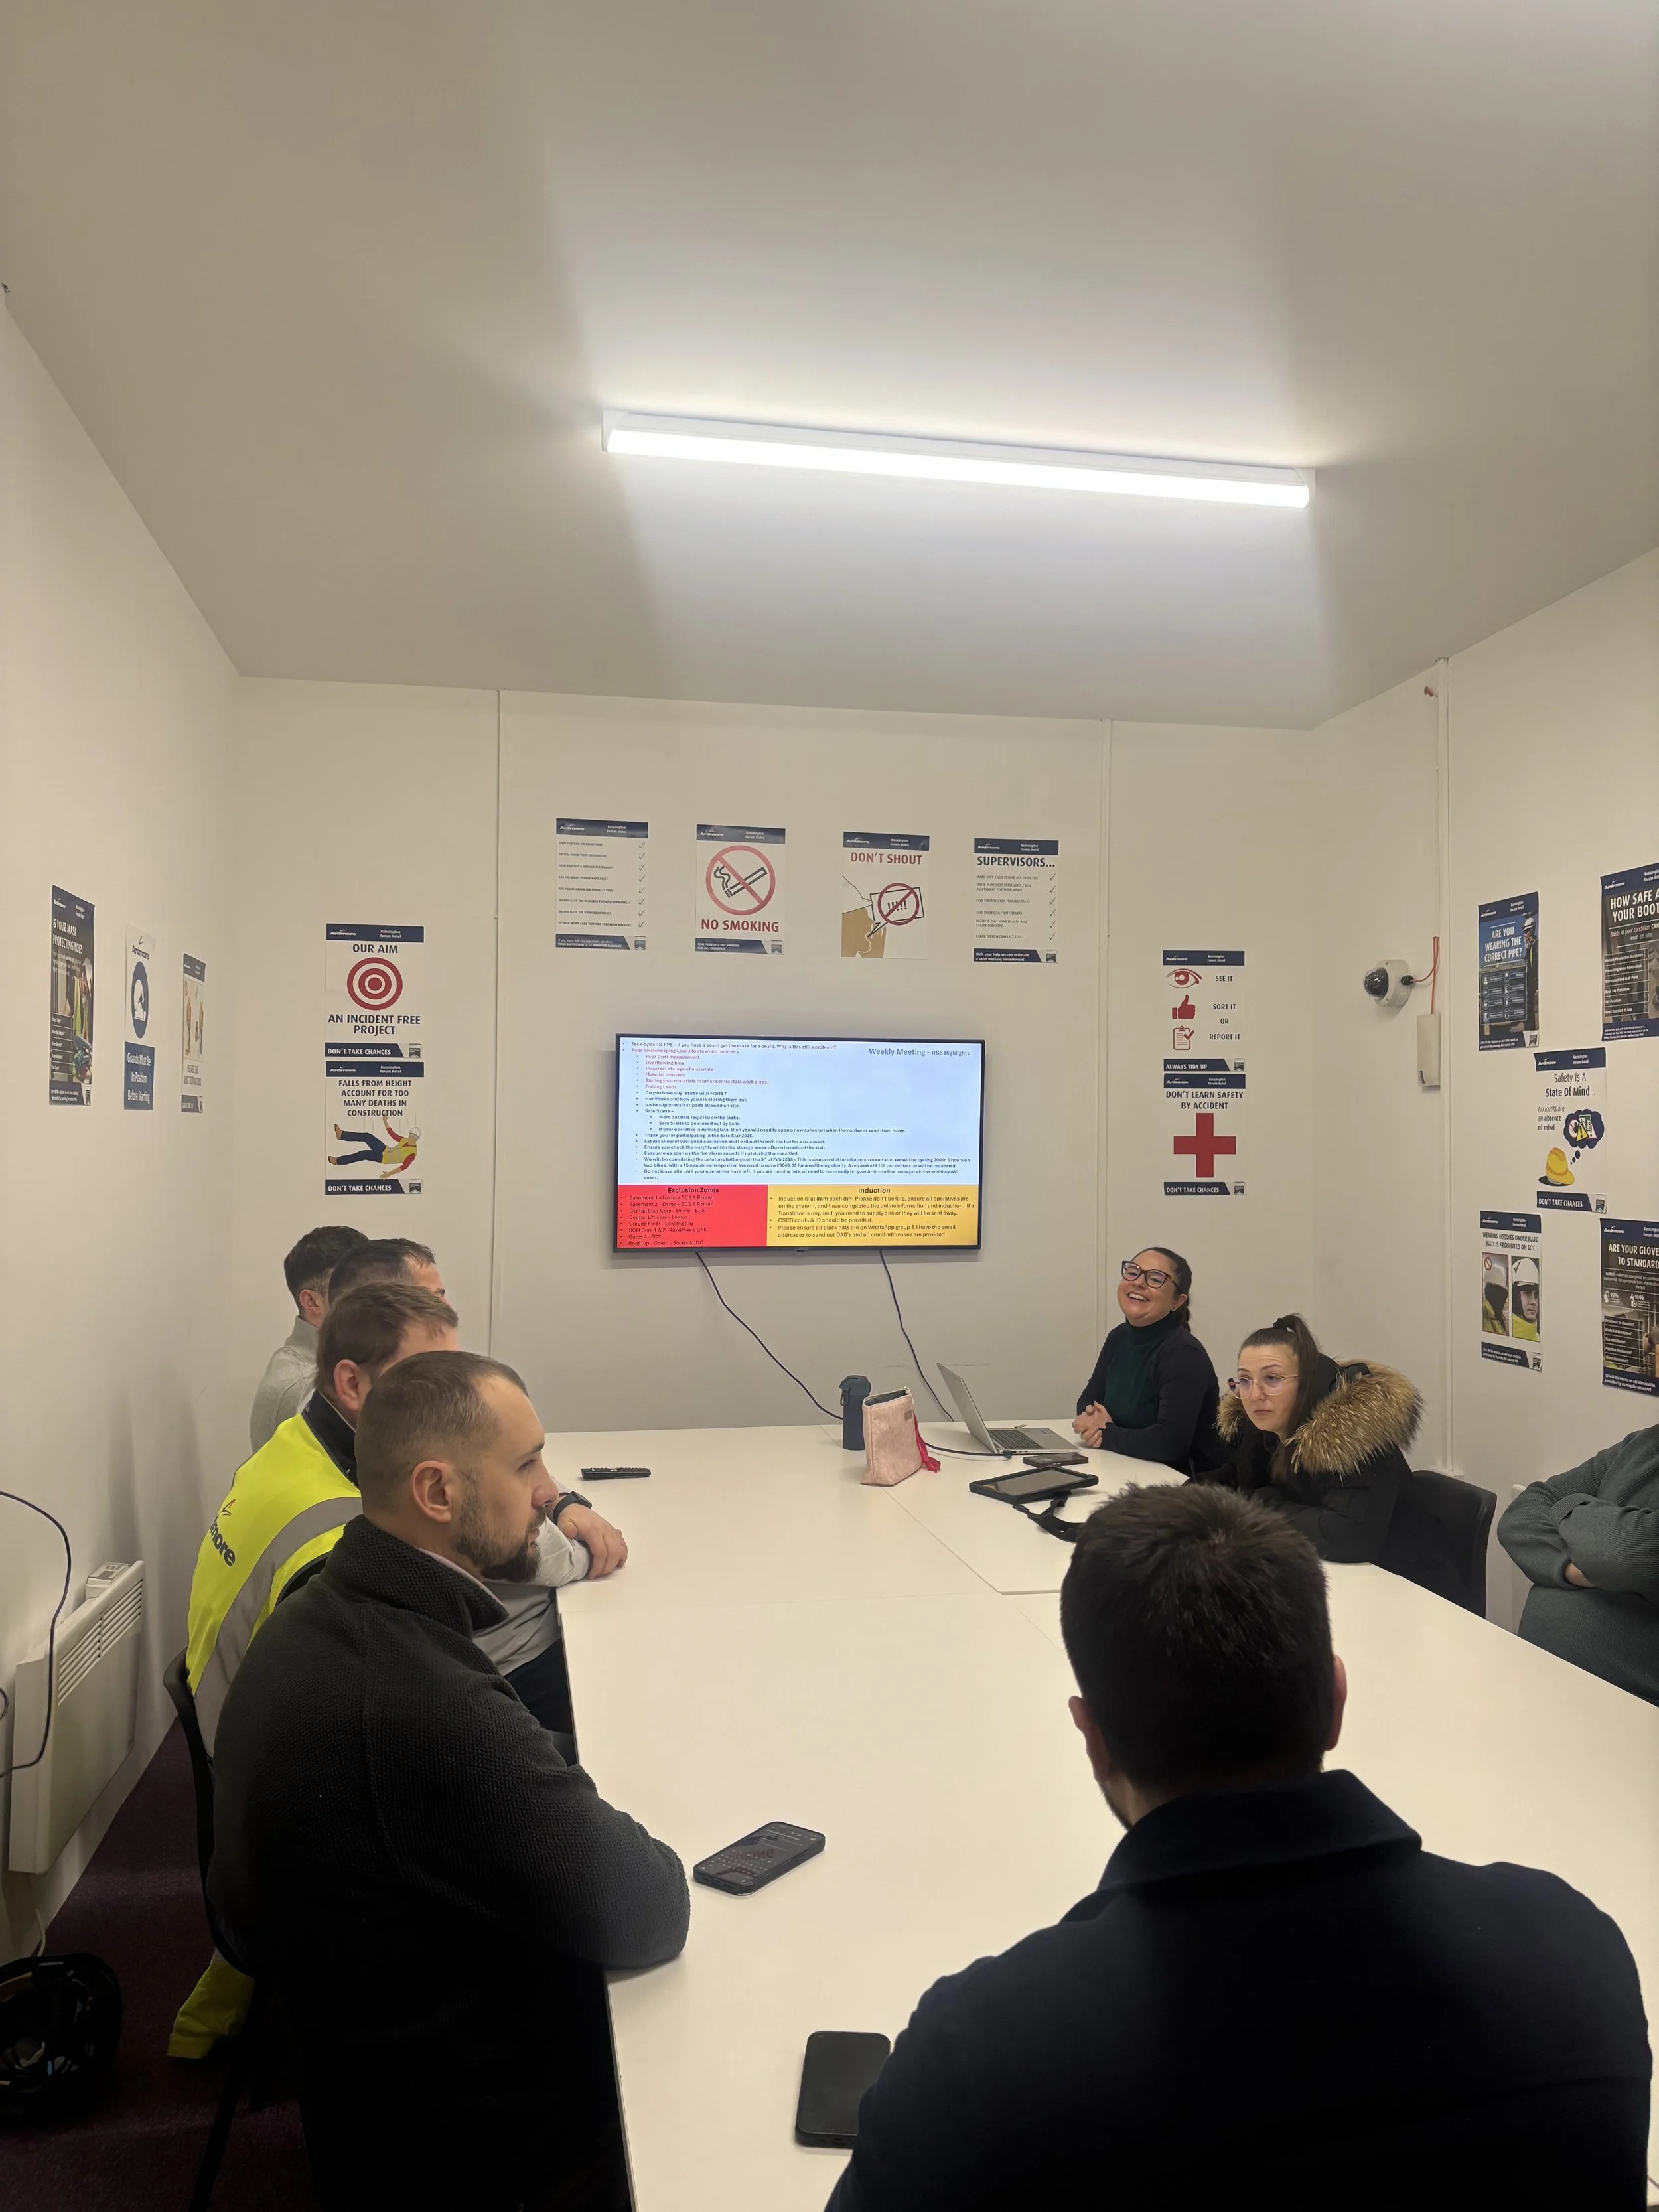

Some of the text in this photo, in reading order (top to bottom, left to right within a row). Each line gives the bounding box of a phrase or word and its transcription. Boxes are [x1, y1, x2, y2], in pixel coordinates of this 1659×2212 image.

[851, 852, 922, 865] DON'T SHOUT
[977, 857, 1056, 867] SUPERVISORS...
[1610, 894, 1630, 910] HOW
[1632, 890, 1652, 905] SAFE
[1612, 902, 1659, 922] YOUR BOOT
[57, 920, 66, 932] YOUR
[67, 923, 78, 936] MASK
[701, 919, 779, 932] NO SMOKING
[1492, 926, 1514, 939] ARE YOU
[53, 934, 74, 951] PROTECTING
[353, 944, 398, 954] OUR AIM
[1485, 936, 1522, 952] WEARING THE
[132, 945, 150, 960] Ardmore
[1484, 948, 1522, 962] CORRECT PPE?
[347, 1015, 394, 1023] INCIDENT
[397, 1015, 421, 1024] FREE
[354, 1025, 395, 1036] PROJECT
[127, 1052, 139, 1064] Guards
[147, 1055, 151, 1067] Be
[897, 1049, 926, 1057] Meeting
[131, 1071, 147, 1084] In Position
[1554, 1072, 1573, 1084] Safety
[1575, 1073, 1580, 1082] Is
[128, 1089, 150, 1104] Before Starting
[1546, 1088, 1562, 1098] State
[1564, 1087, 1572, 1096] Of
[1608, 1243, 1659, 1256] ARE YOUR GLOVE
[1617, 1256, 1625, 1266] TO
